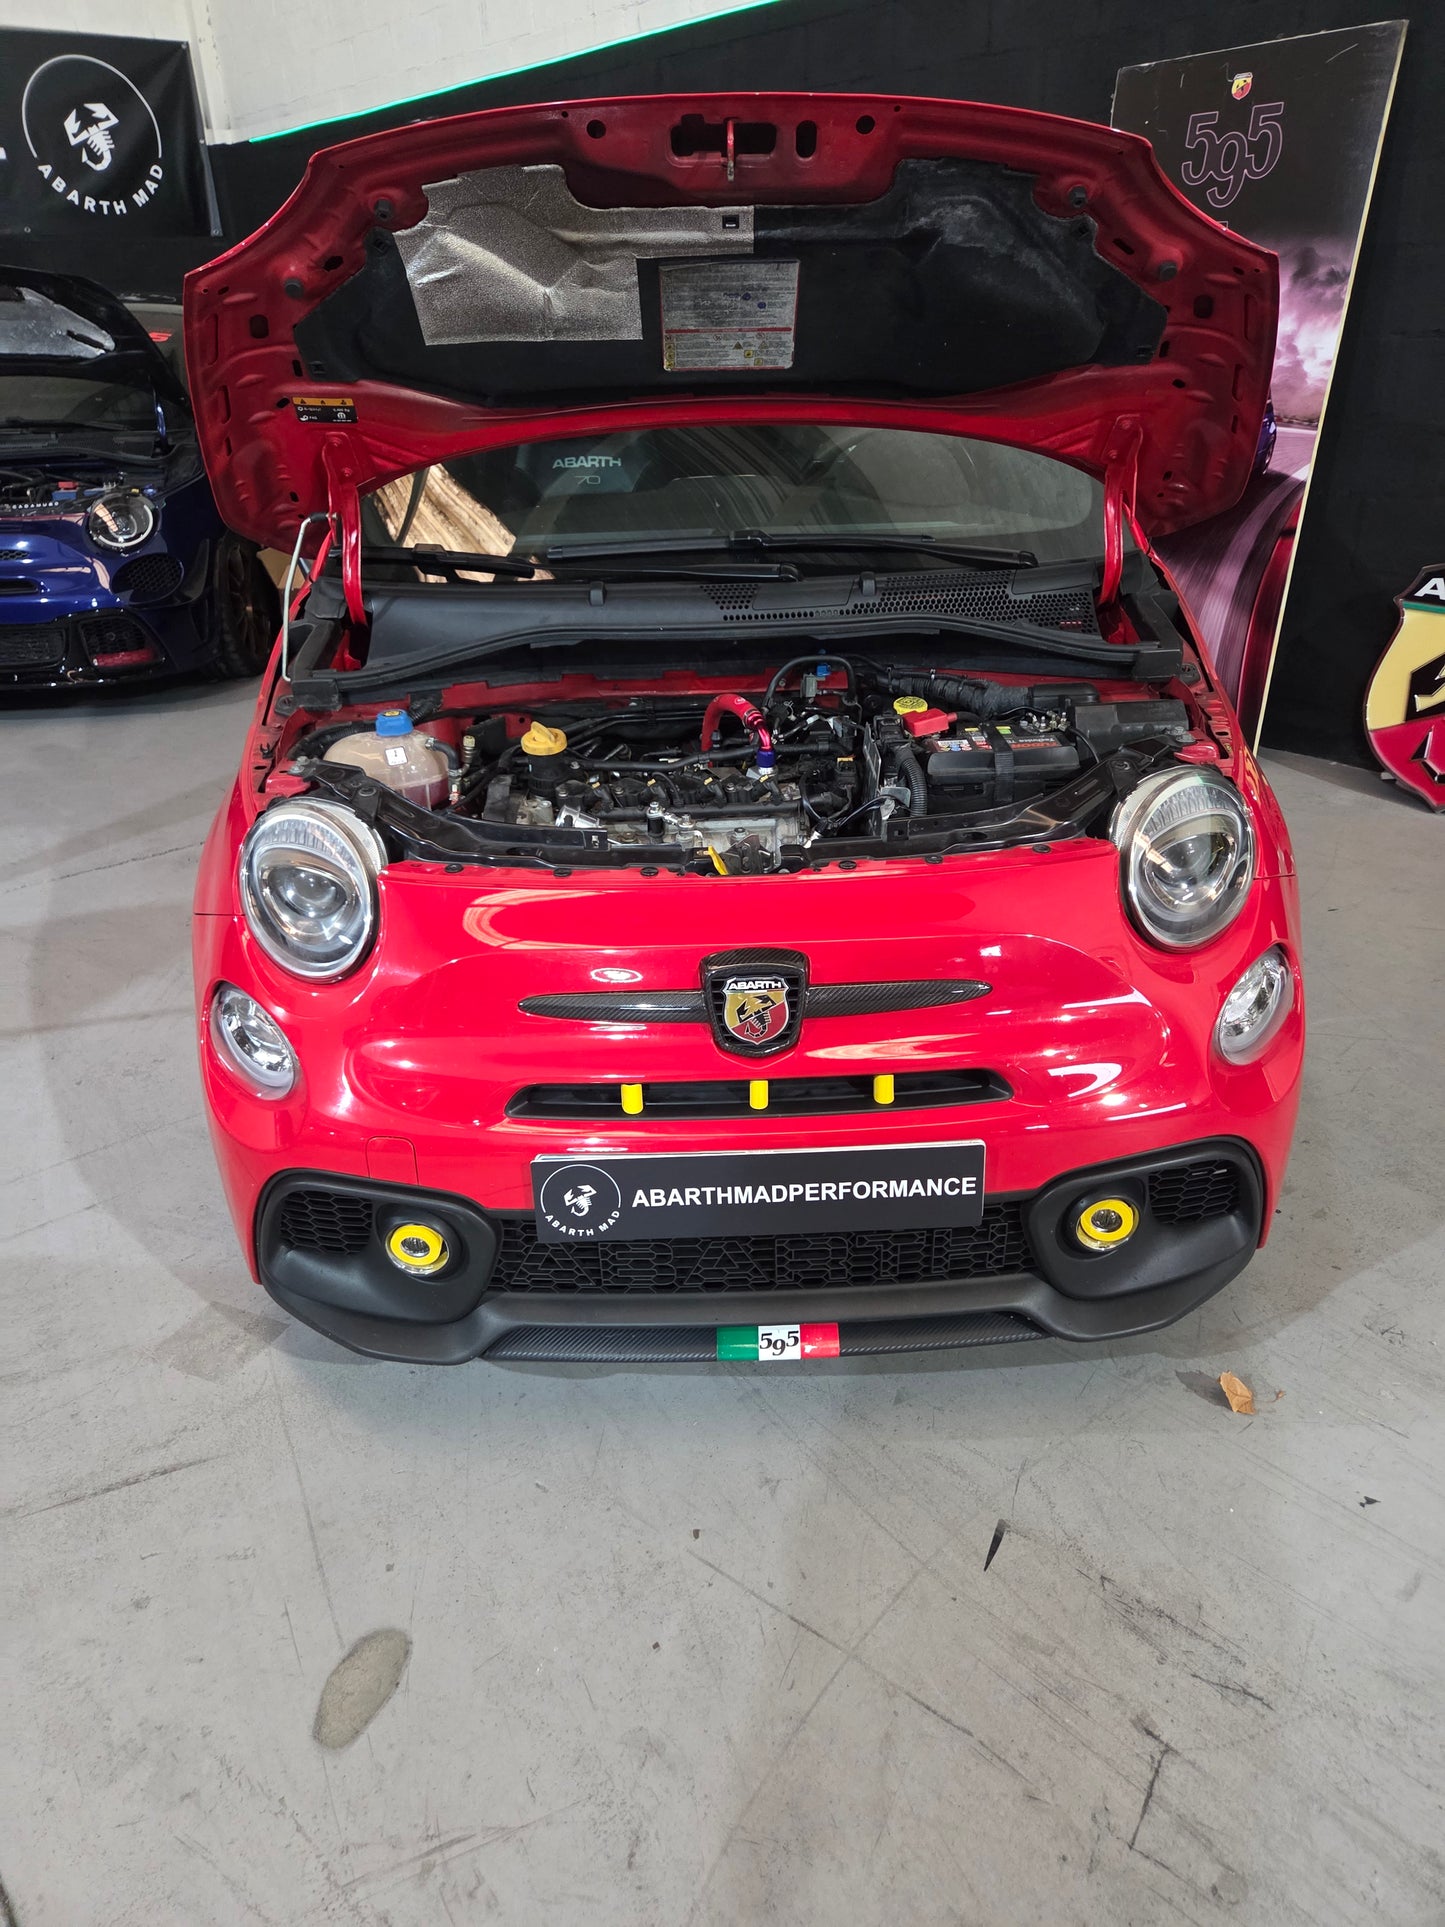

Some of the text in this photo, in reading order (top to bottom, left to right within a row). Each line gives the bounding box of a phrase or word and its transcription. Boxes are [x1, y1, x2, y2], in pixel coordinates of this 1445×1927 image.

[1181, 102, 1284, 208] 595
[38, 164, 163, 215] ABARTH MAD
[552, 455, 622, 469] ABARTH
[728, 980, 782, 991] ABARTH
[632, 1177, 977, 1207] ABARTHMADPERFORMANCE
[545, 1210, 620, 1237] ABARTH MAD
[759, 1330, 800, 1356] 595
